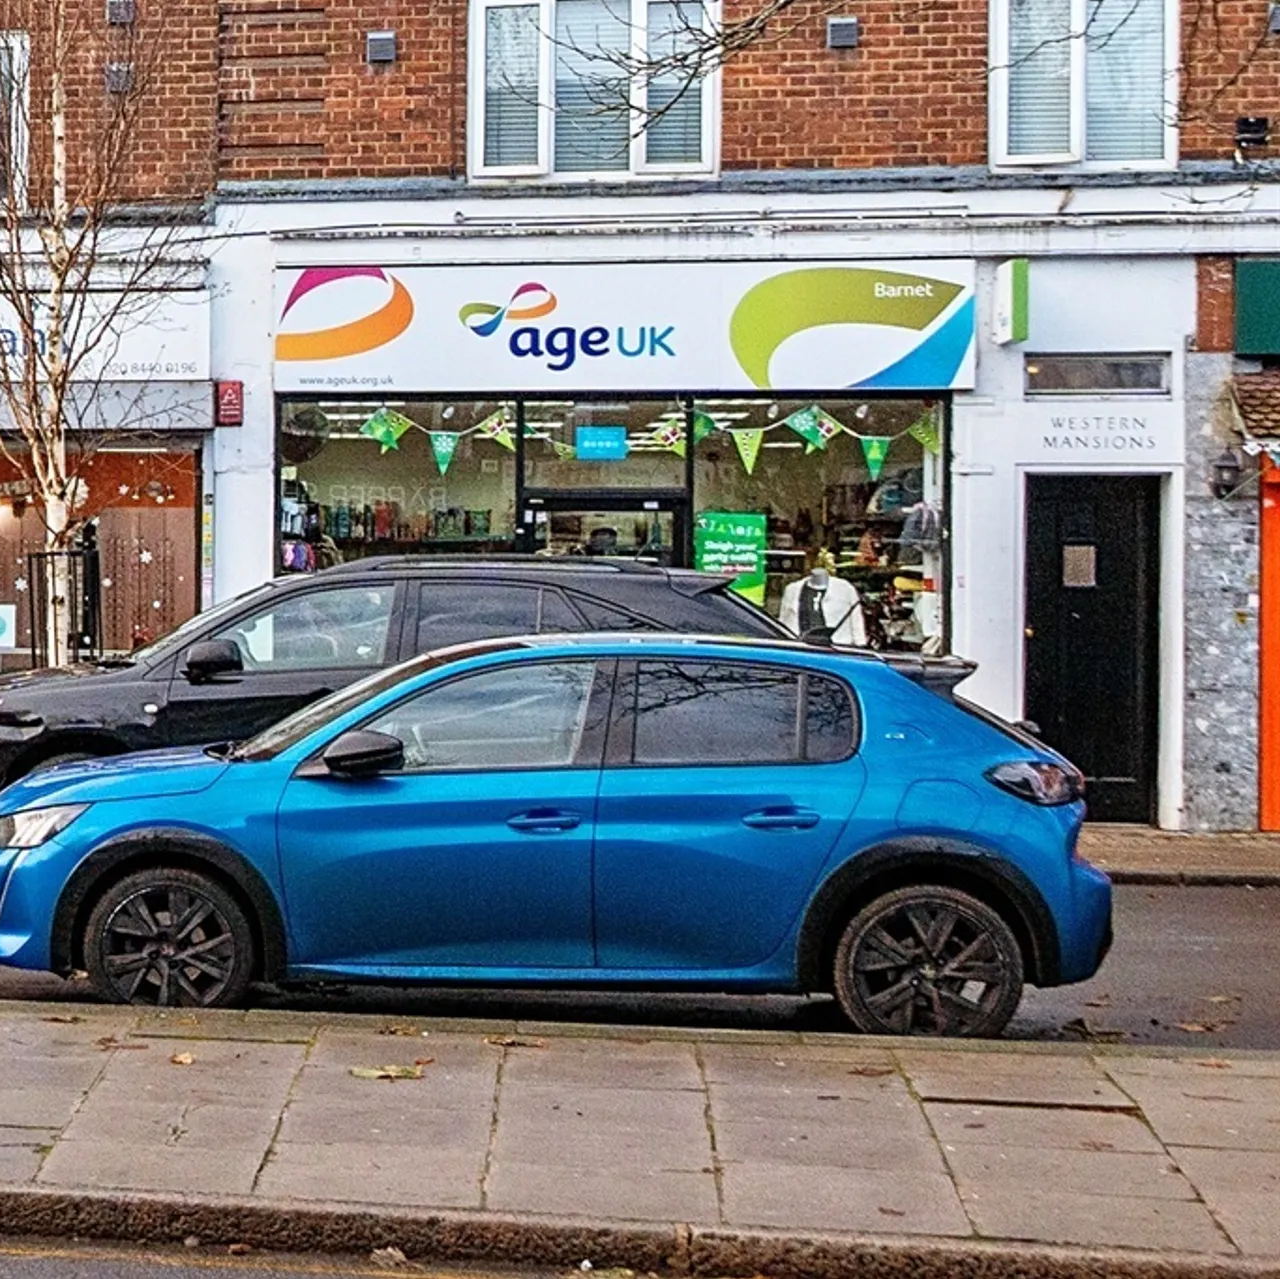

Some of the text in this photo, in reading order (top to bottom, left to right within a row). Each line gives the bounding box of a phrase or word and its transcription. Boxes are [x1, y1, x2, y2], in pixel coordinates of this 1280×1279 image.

[874, 282, 934, 298] Barnet
[299, 374, 394, 388] www.ageuk.org.uk
[1050, 416, 1147, 431] WESTERN
[1042, 435, 1156, 450] MANSIONS
